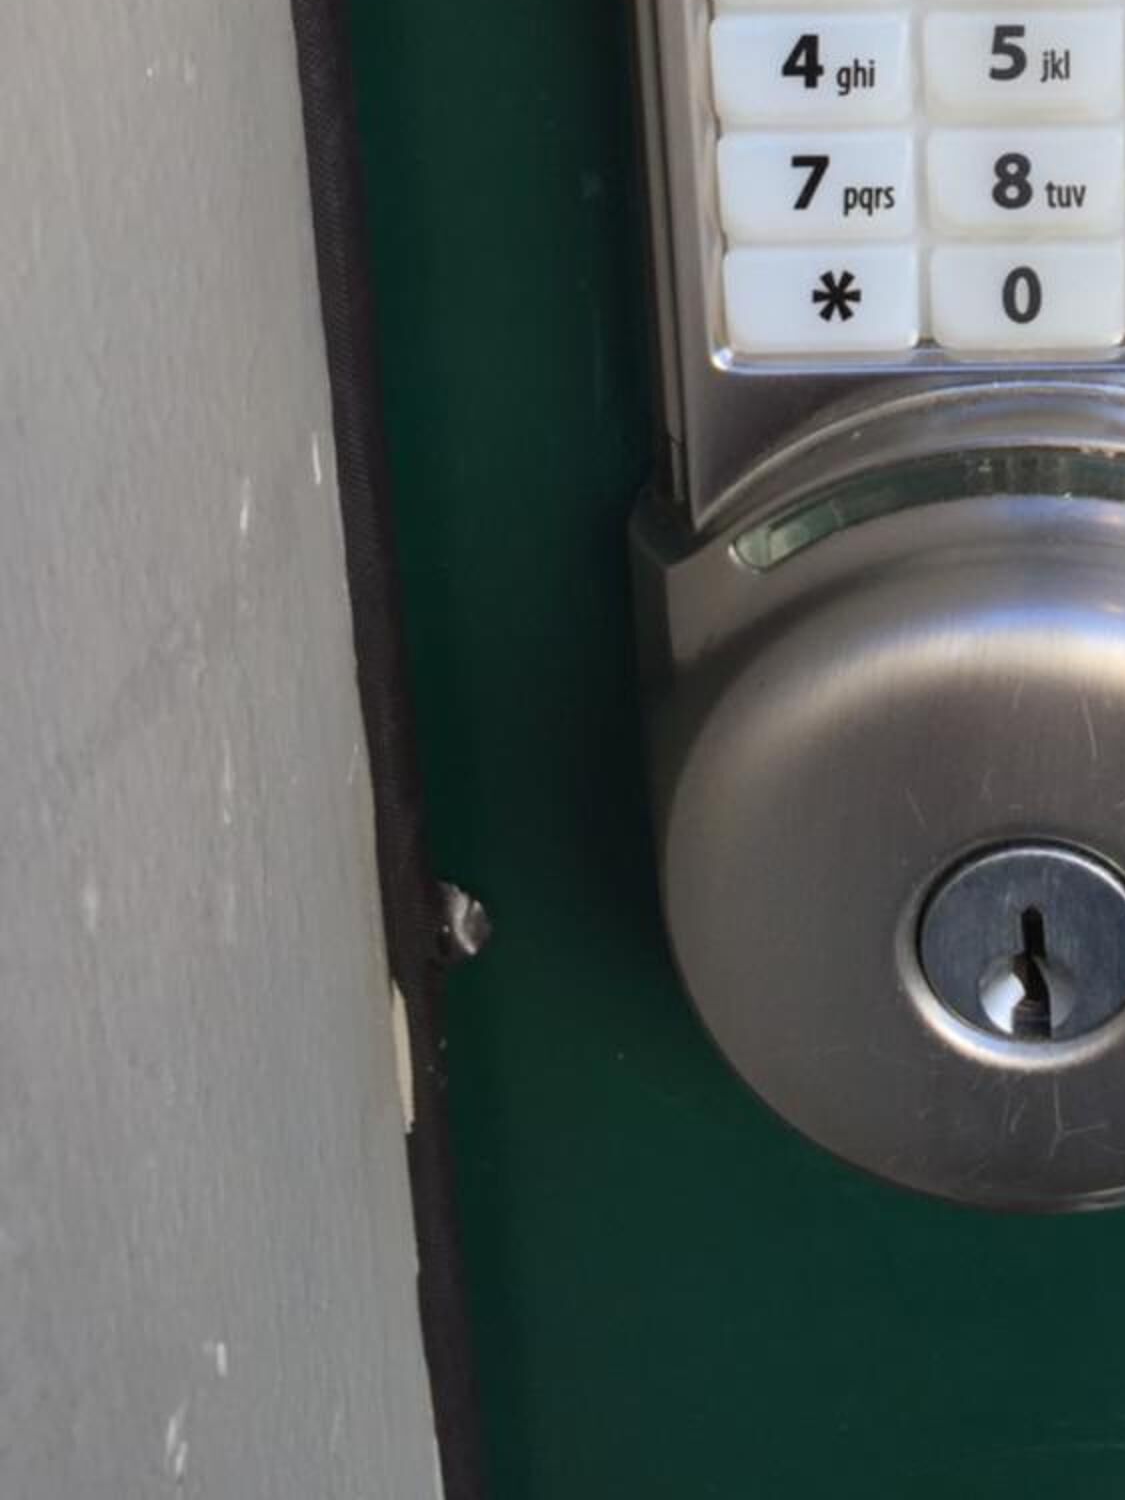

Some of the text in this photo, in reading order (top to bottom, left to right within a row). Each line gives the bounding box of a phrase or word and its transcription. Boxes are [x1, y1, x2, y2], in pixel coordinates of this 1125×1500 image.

[780, 32, 876, 97] 4 ghi
[988, 23, 1071, 84] 5 jkl
[789, 153, 896, 218] 7 pqrs
[990, 151, 1087, 211] 8 tuv
[1000, 264, 1043, 325] 0
